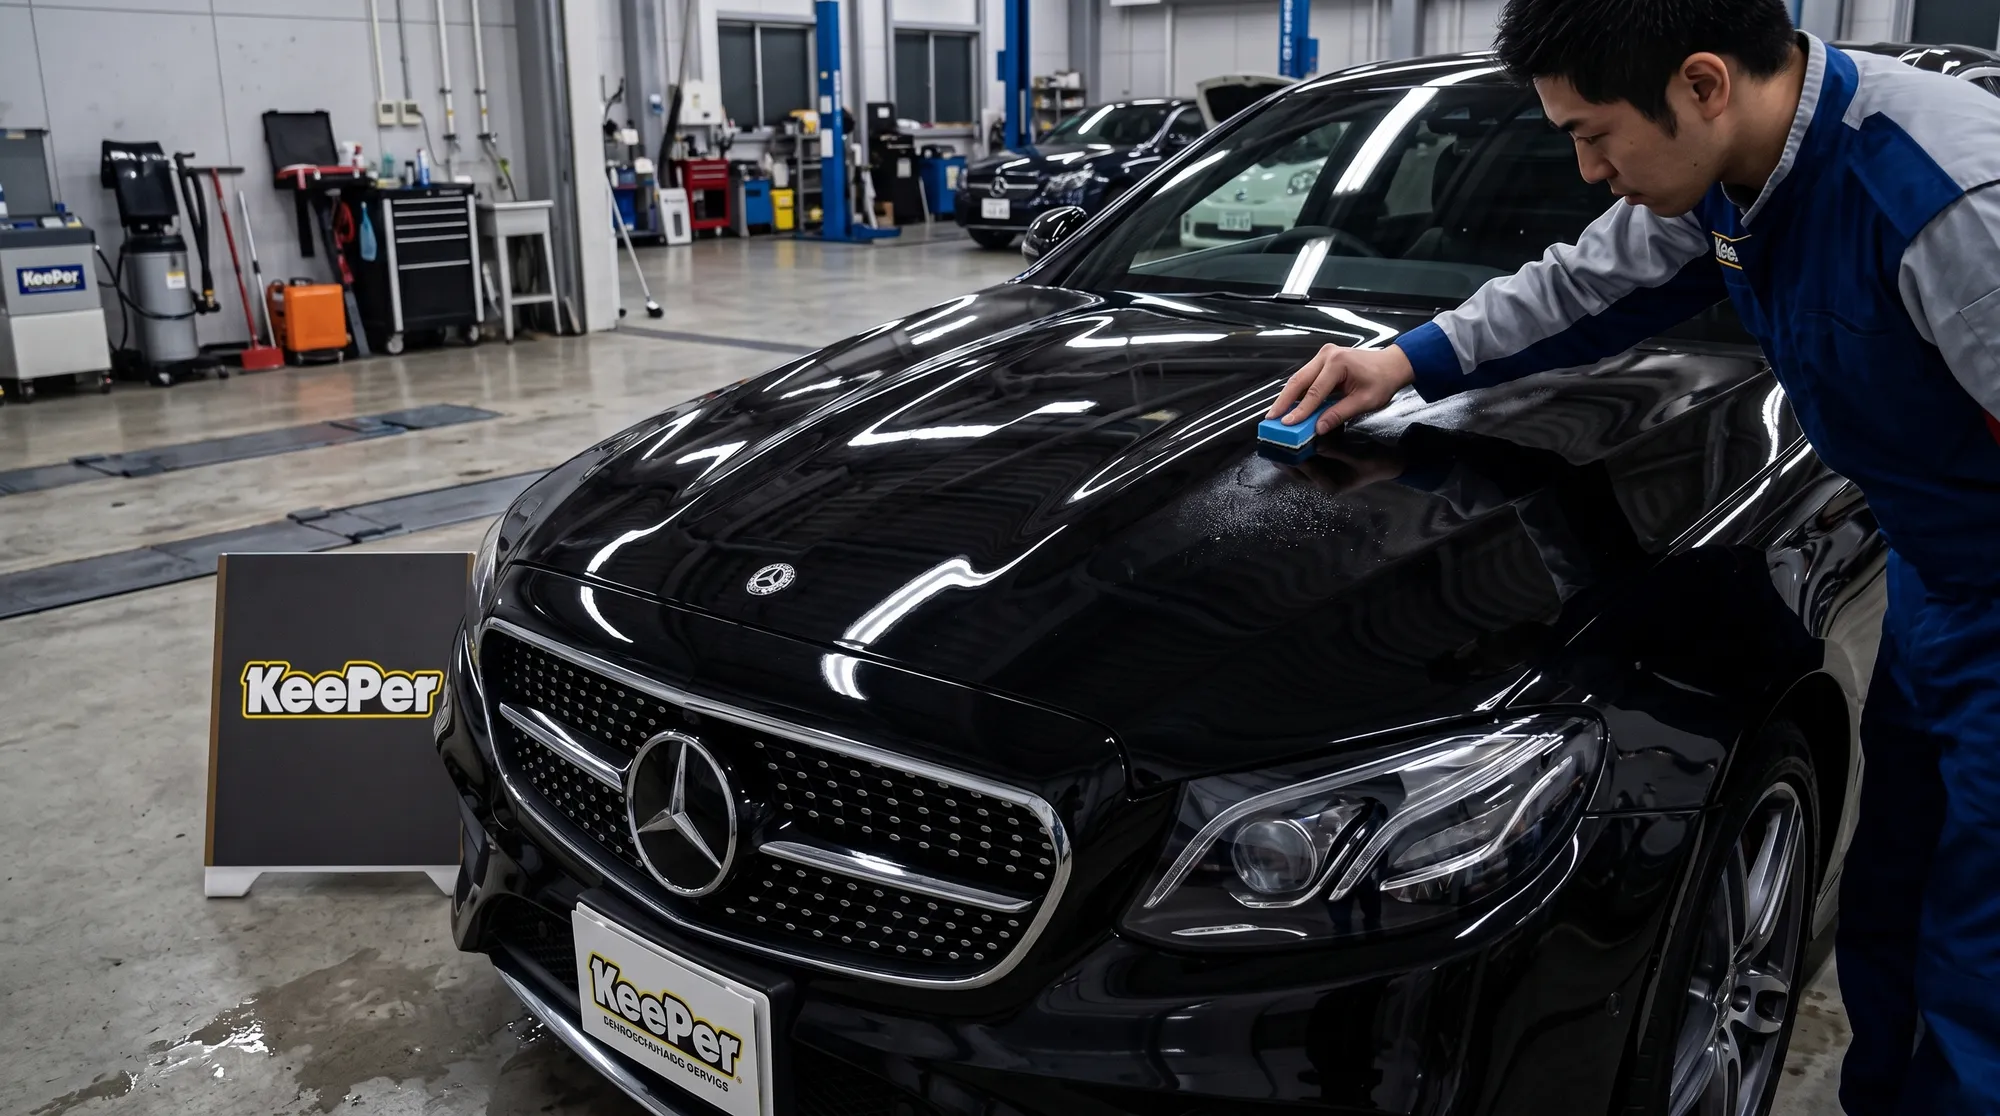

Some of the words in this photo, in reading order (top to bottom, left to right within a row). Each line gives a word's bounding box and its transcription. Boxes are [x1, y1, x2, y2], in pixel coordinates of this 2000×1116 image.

[1714, 236, 1739, 262] Kee
[22, 268, 79, 286] KeePer
[243, 663, 440, 715] KeePer
[588, 952, 742, 1077] KeePer
